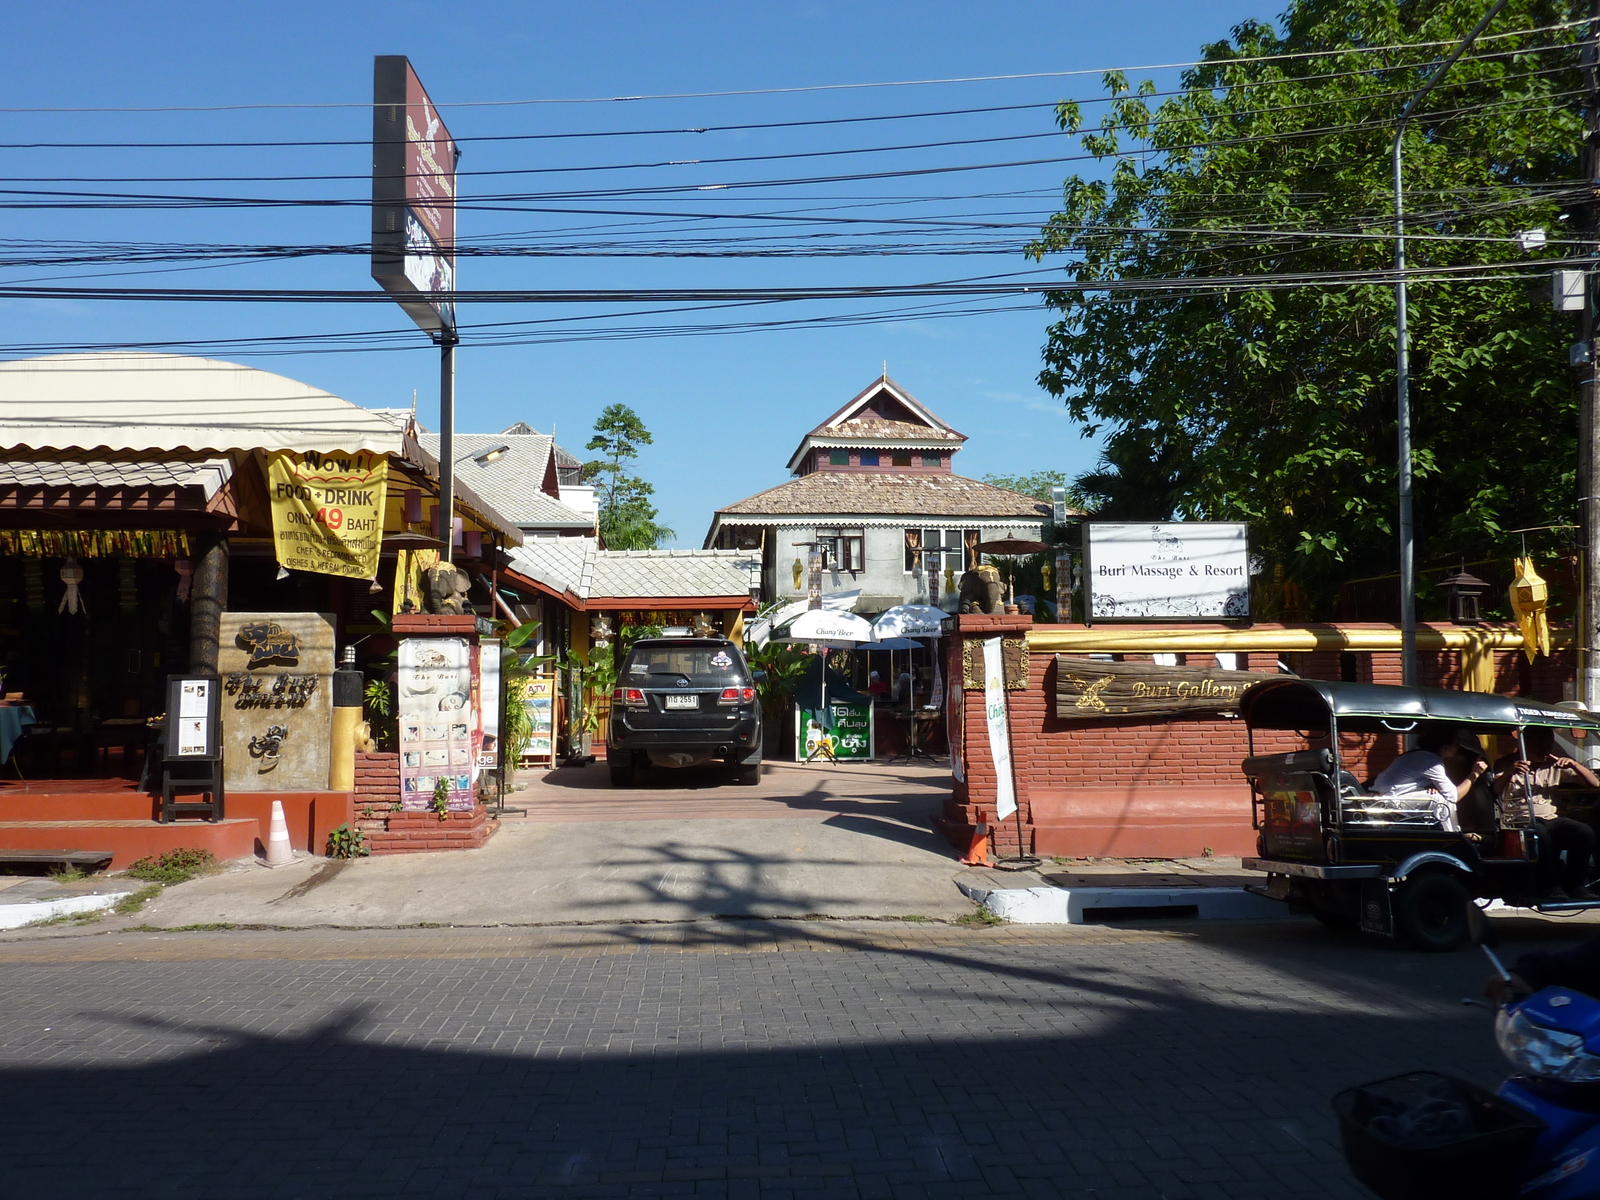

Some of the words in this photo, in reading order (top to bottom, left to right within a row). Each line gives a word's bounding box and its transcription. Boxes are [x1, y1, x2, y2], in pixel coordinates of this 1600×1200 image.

[277, 483, 312, 501] FOOD
[325, 489, 374, 506] DRINK
[287, 512, 314, 526] ONLY
[316, 508, 343, 529] 49
[347, 518, 377, 531] BAHT
[286, 557, 309, 568] DISHES
[318, 561, 339, 573] HERBAL
[1099, 564, 1126, 576] Buri
[1131, 564, 1183, 580] Massage
[1189, 565, 1199, 576] &
[1205, 564, 1243, 576] Resort
[816, 628, 836, 636] Chang
[901, 626, 920, 634] Chang
[528, 685, 546, 693] ATV
[1132, 681, 1171, 698] Buri
[1177, 679, 1237, 702] Gallery
